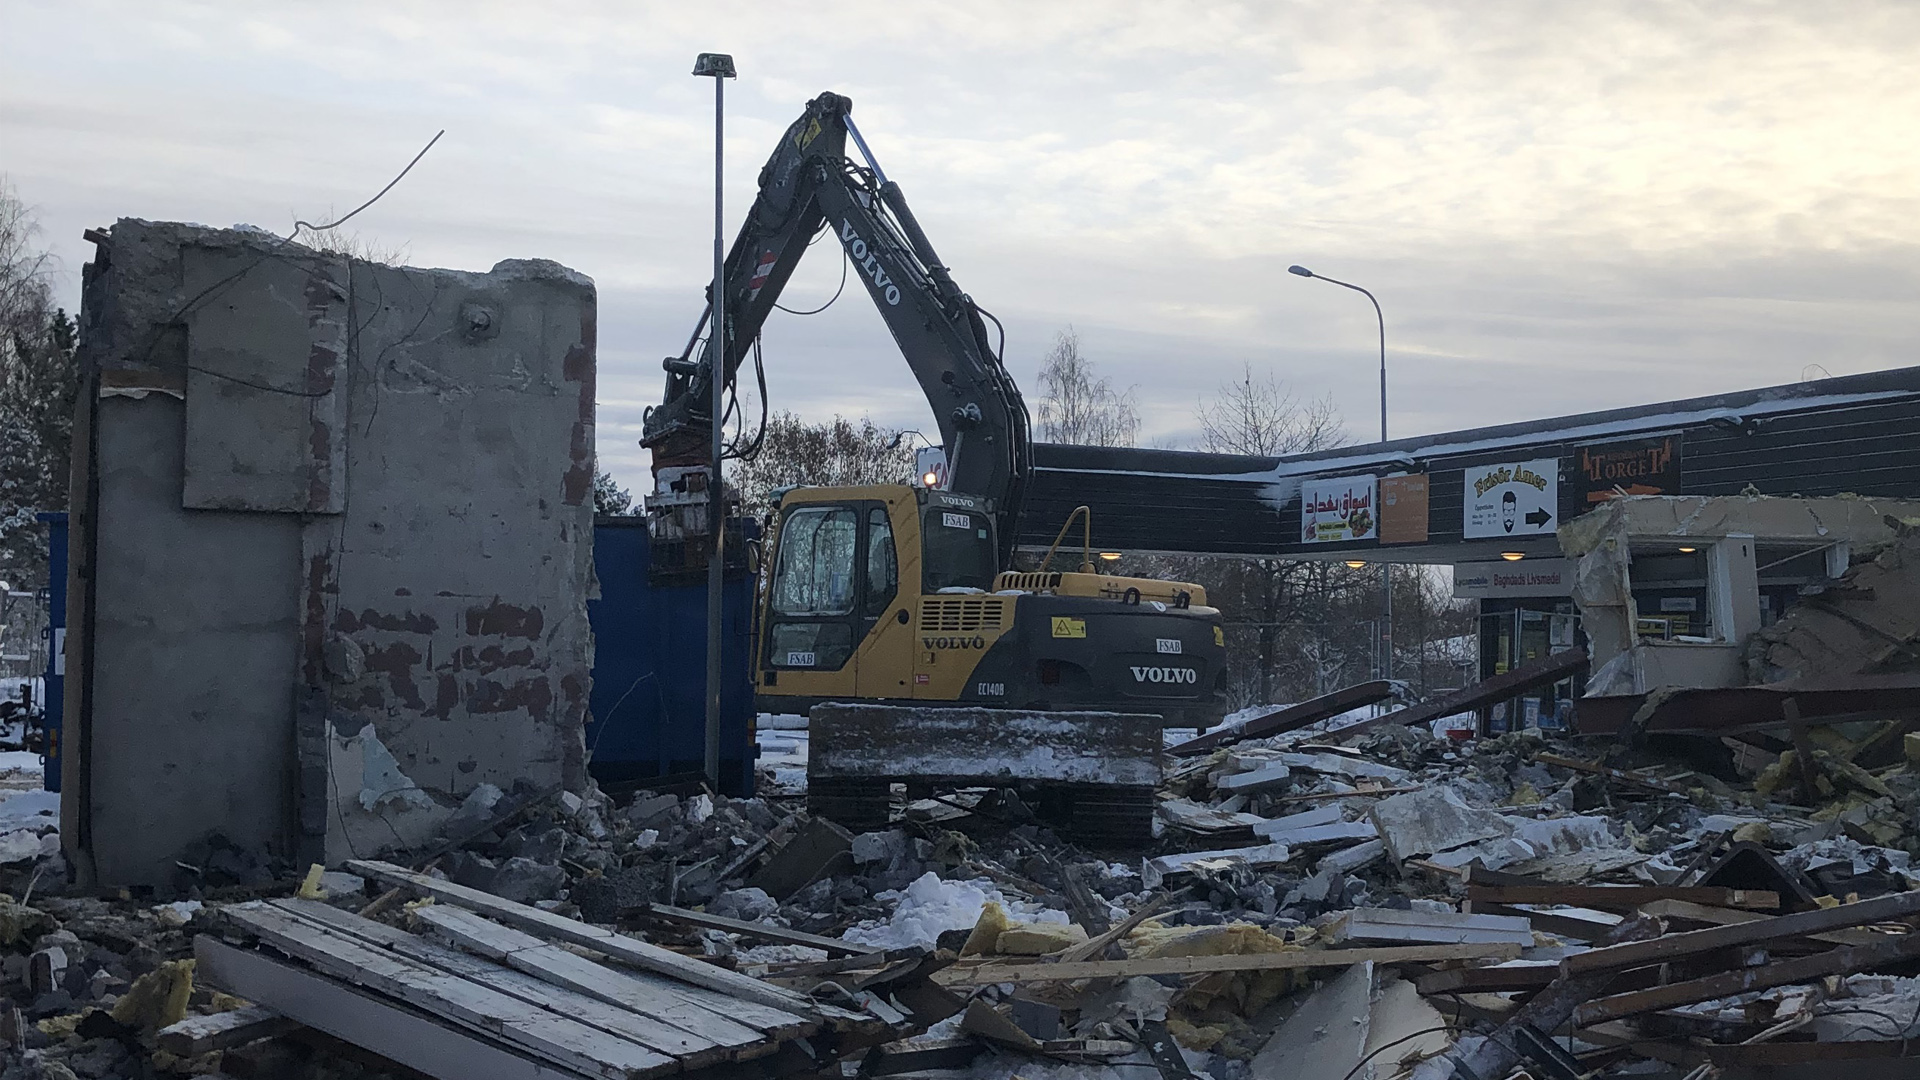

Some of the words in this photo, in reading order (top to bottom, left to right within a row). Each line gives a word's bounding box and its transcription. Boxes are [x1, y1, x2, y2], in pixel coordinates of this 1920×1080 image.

[841, 218, 900, 306] VOLVO
[1590, 448, 1664, 481] TORGET
[1474, 466, 1511, 498] Frisör
[1511, 464, 1547, 492] Amer
[940, 496, 974, 507] VOLVO
[1305, 491, 1338, 517] بغداد
[945, 514, 968, 527] FSAB
[1493, 572, 1525, 588] Baghdads
[1528, 572, 1561, 584] Livsmedel
[922, 637, 985, 649] VOLVO
[1158, 640, 1180, 653] FSAB
[789, 653, 814, 665] FSAB
[1129, 666, 1197, 685] VOLVO
[978, 682, 1005, 696] EC140B
